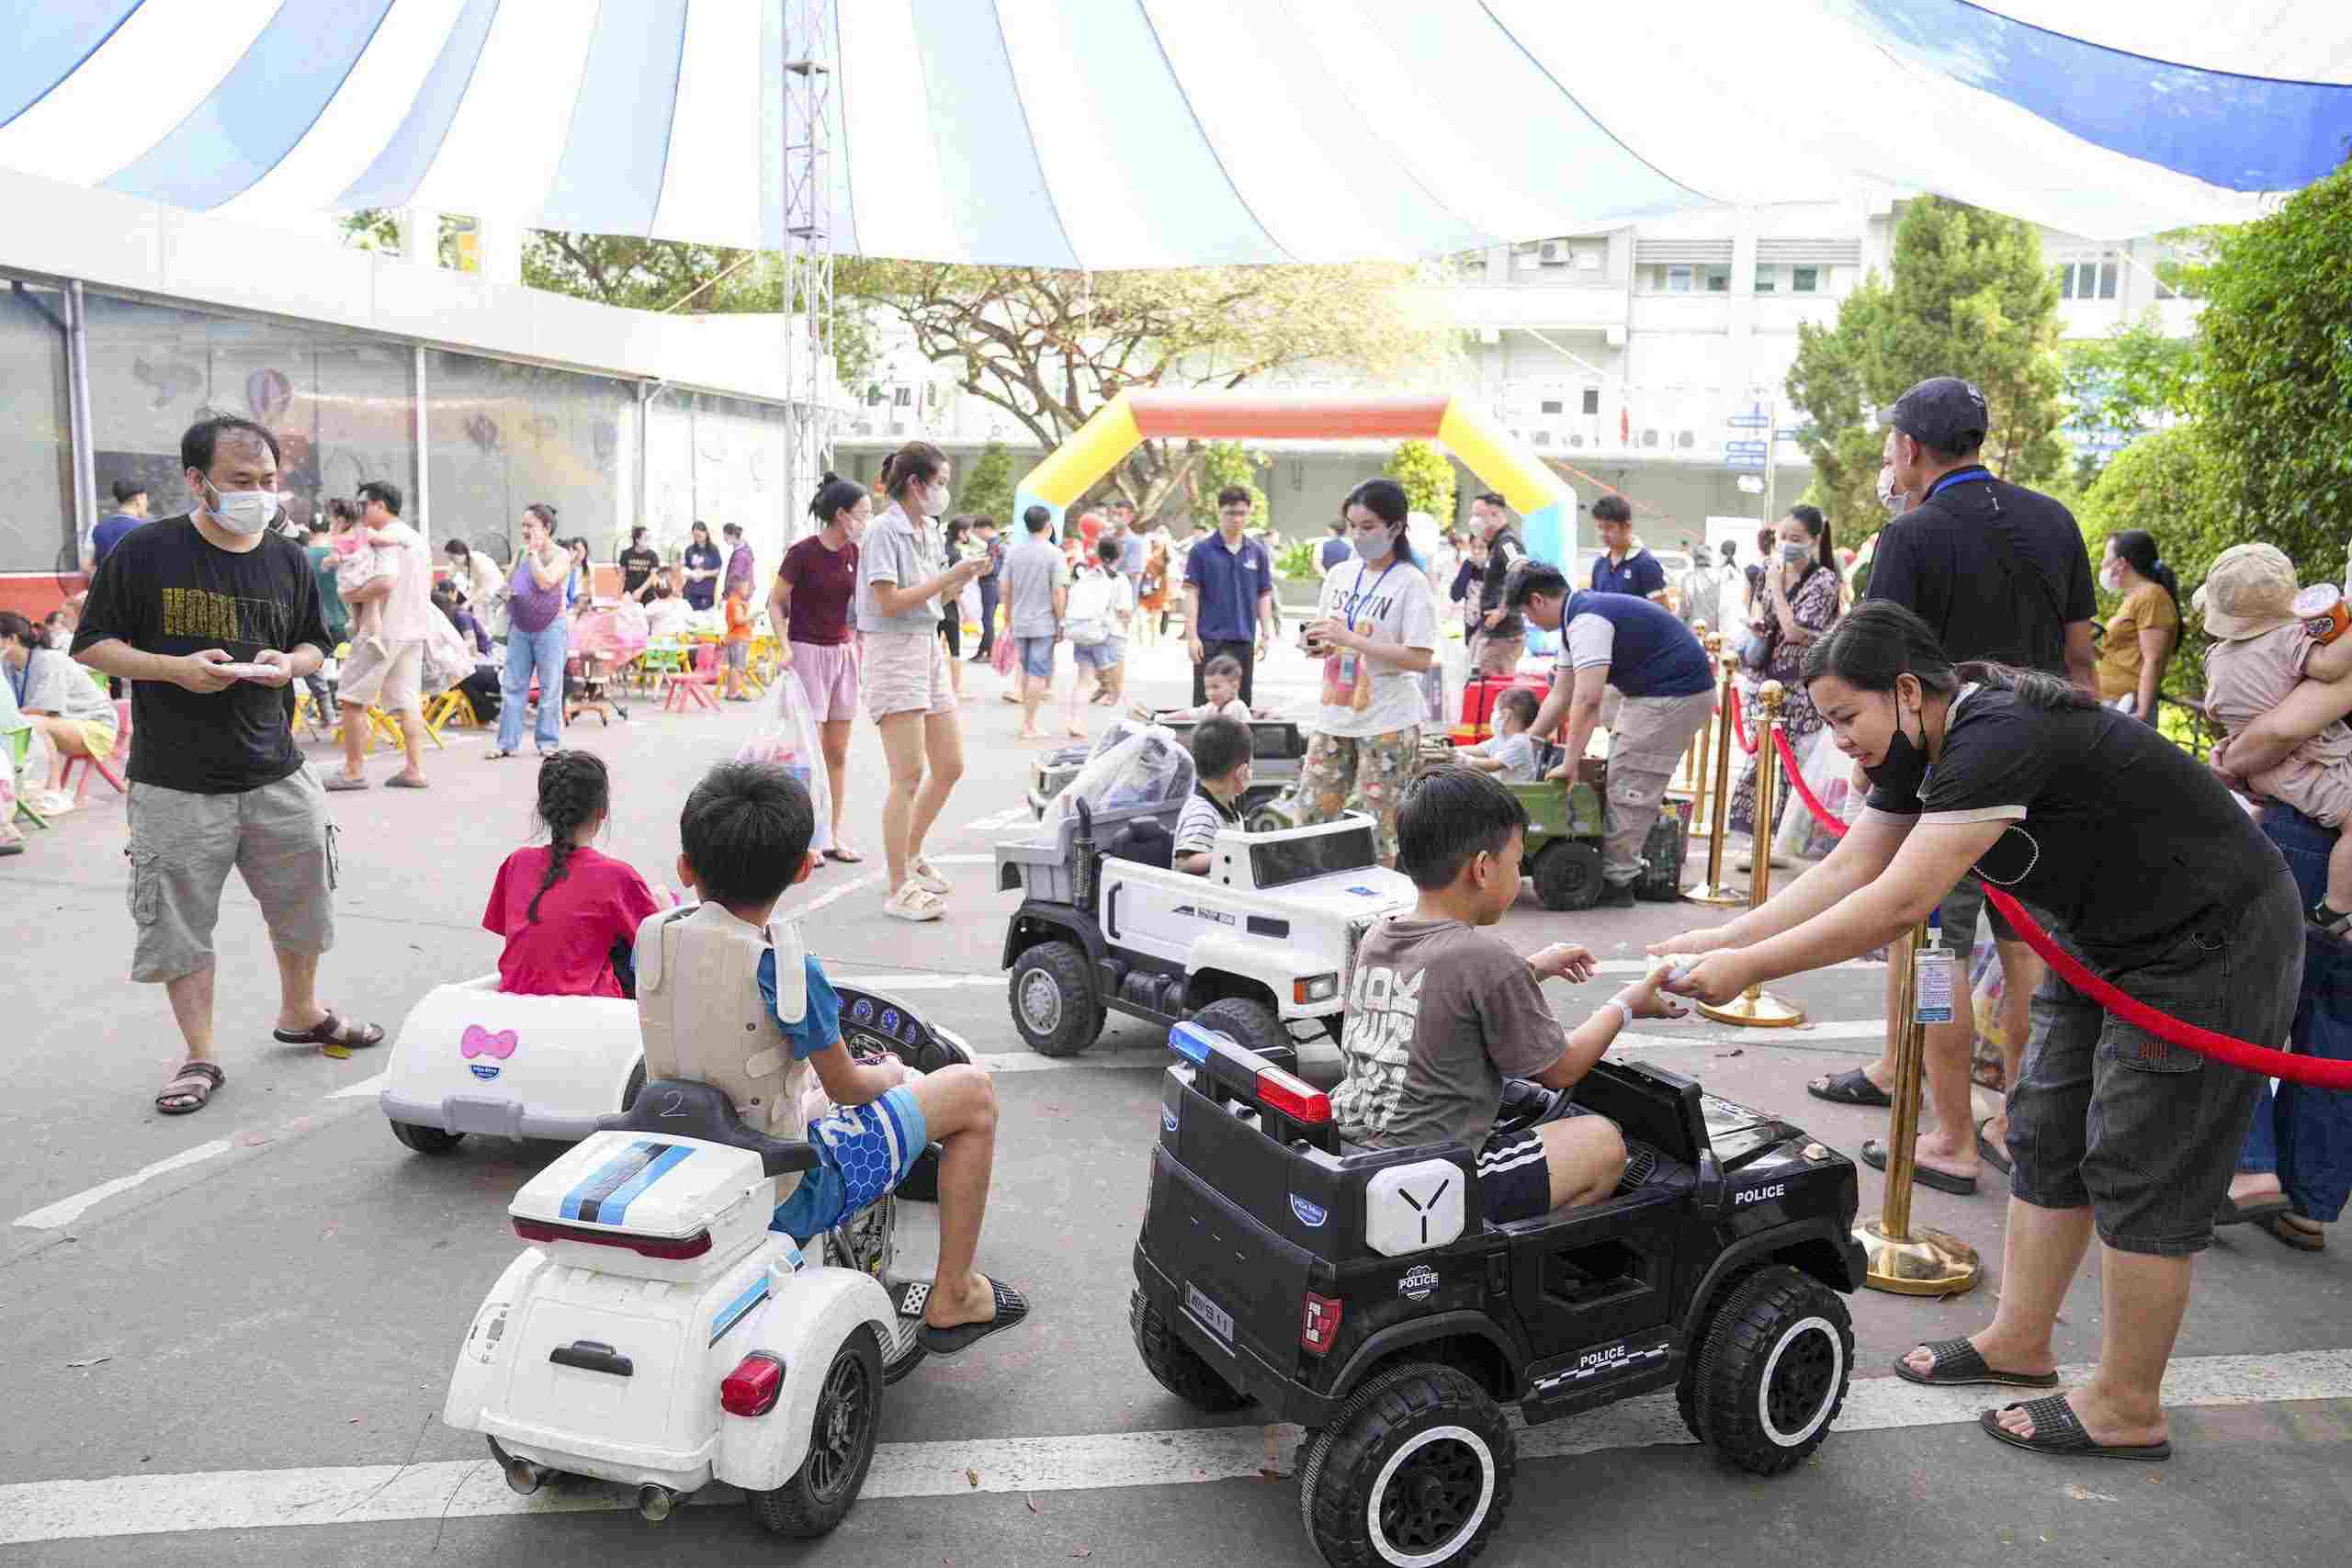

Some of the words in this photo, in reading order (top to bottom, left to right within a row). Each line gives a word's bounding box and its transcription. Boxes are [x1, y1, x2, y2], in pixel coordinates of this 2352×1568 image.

[660, 1089, 688, 1118] 2
[1735, 1183, 1785, 1205] POLICE
[1397, 1273, 1439, 1290] POLICE
[1579, 1345, 1625, 1368] POLICE
